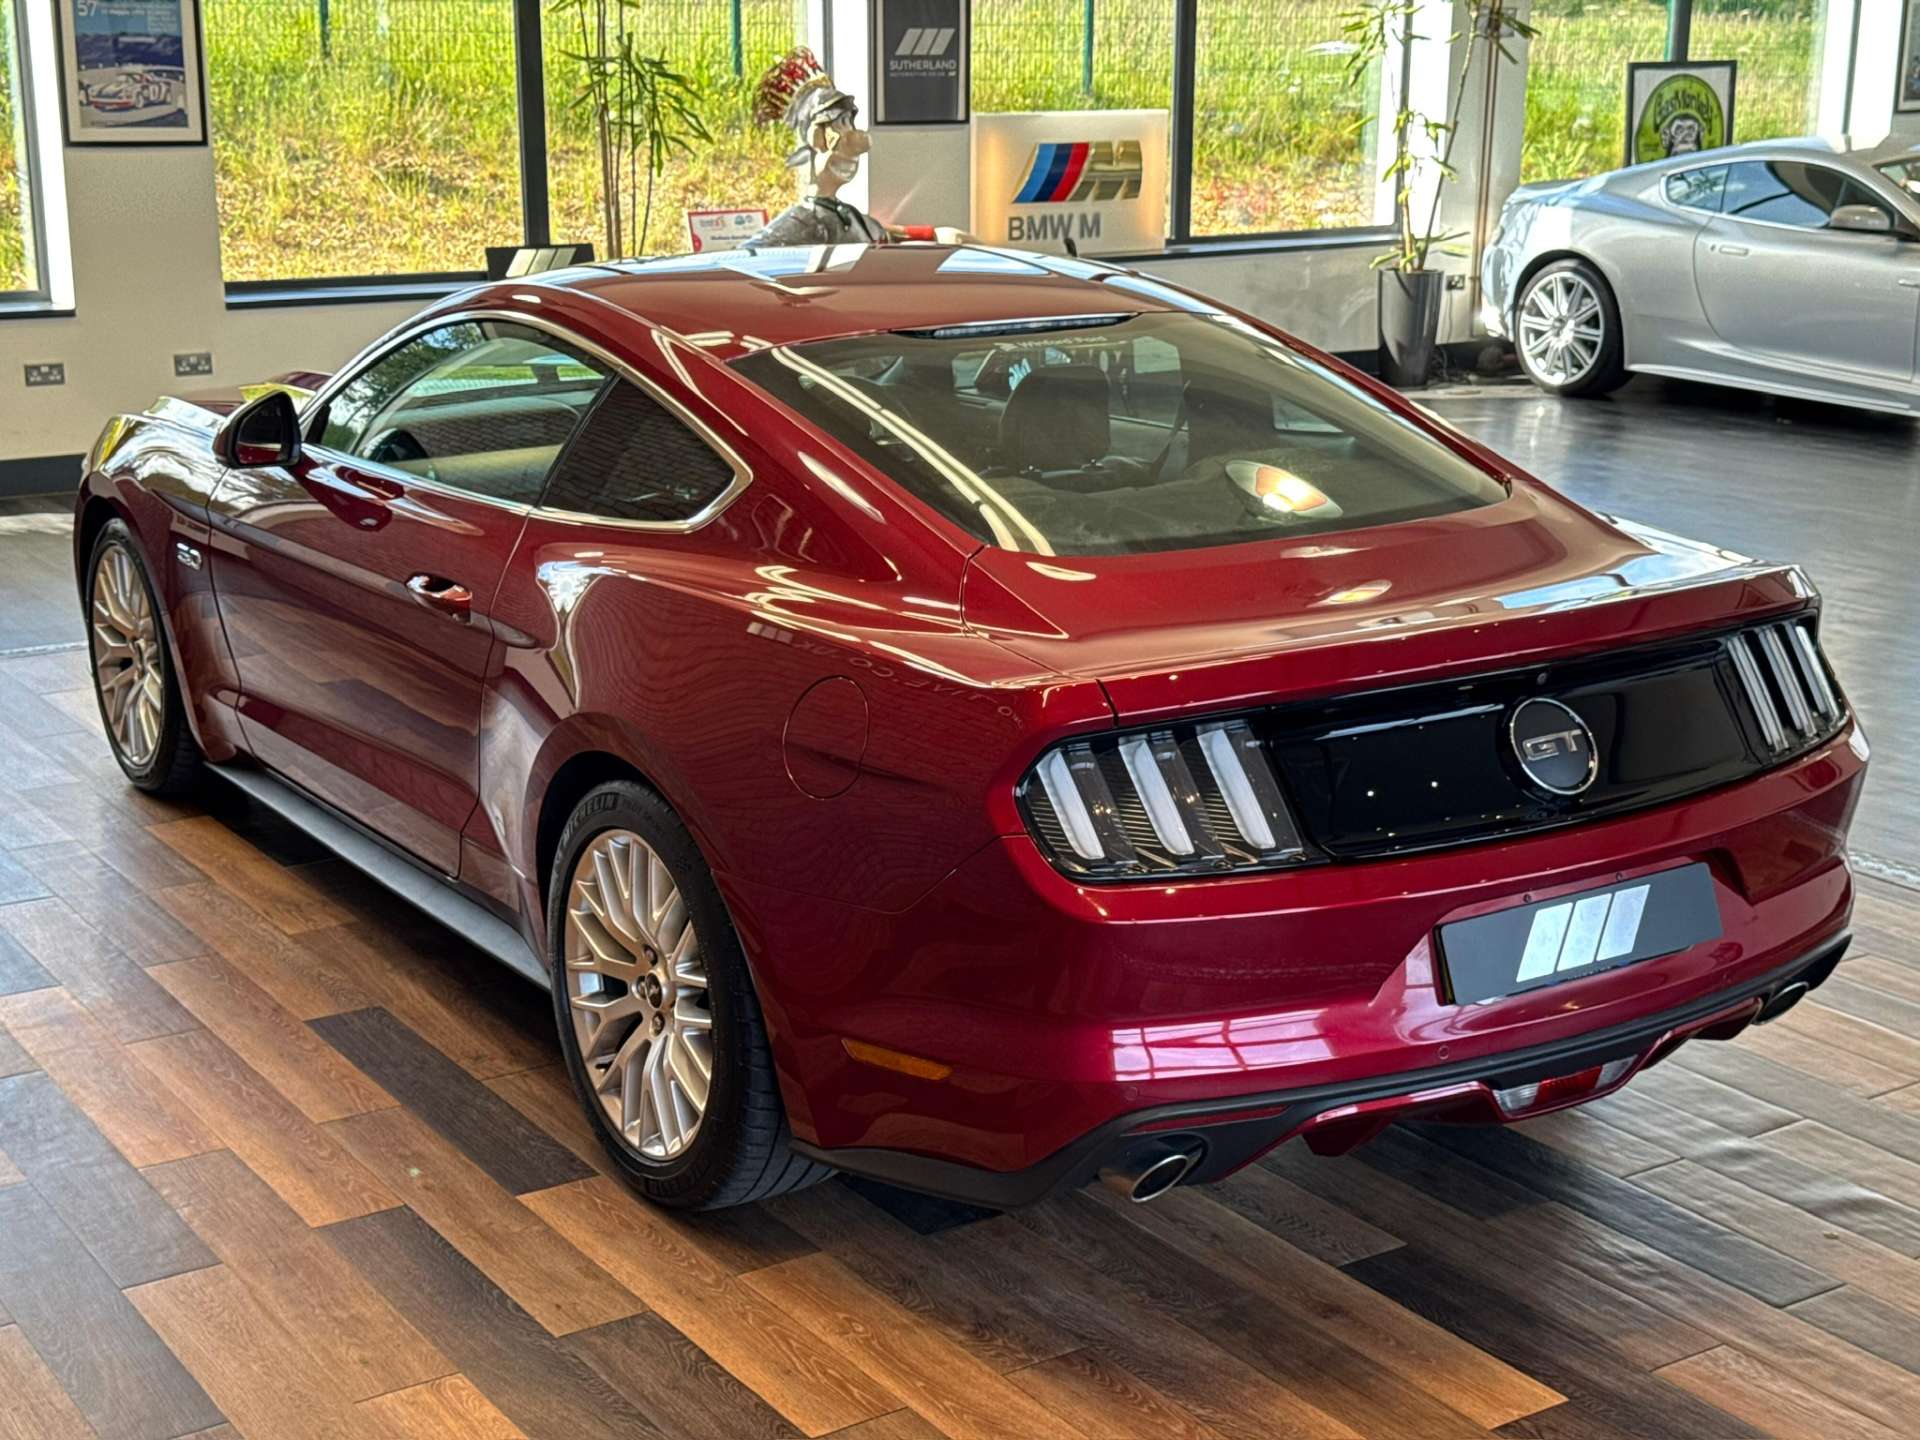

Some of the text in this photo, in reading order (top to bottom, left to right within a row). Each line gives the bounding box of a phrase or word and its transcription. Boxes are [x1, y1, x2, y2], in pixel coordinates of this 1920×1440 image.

[77, 0, 97, 17] 57
[889, 60, 957, 71] SUTHERLAND
[1007, 211, 1101, 242] BMW M
[1521, 728, 1583, 762] GT
